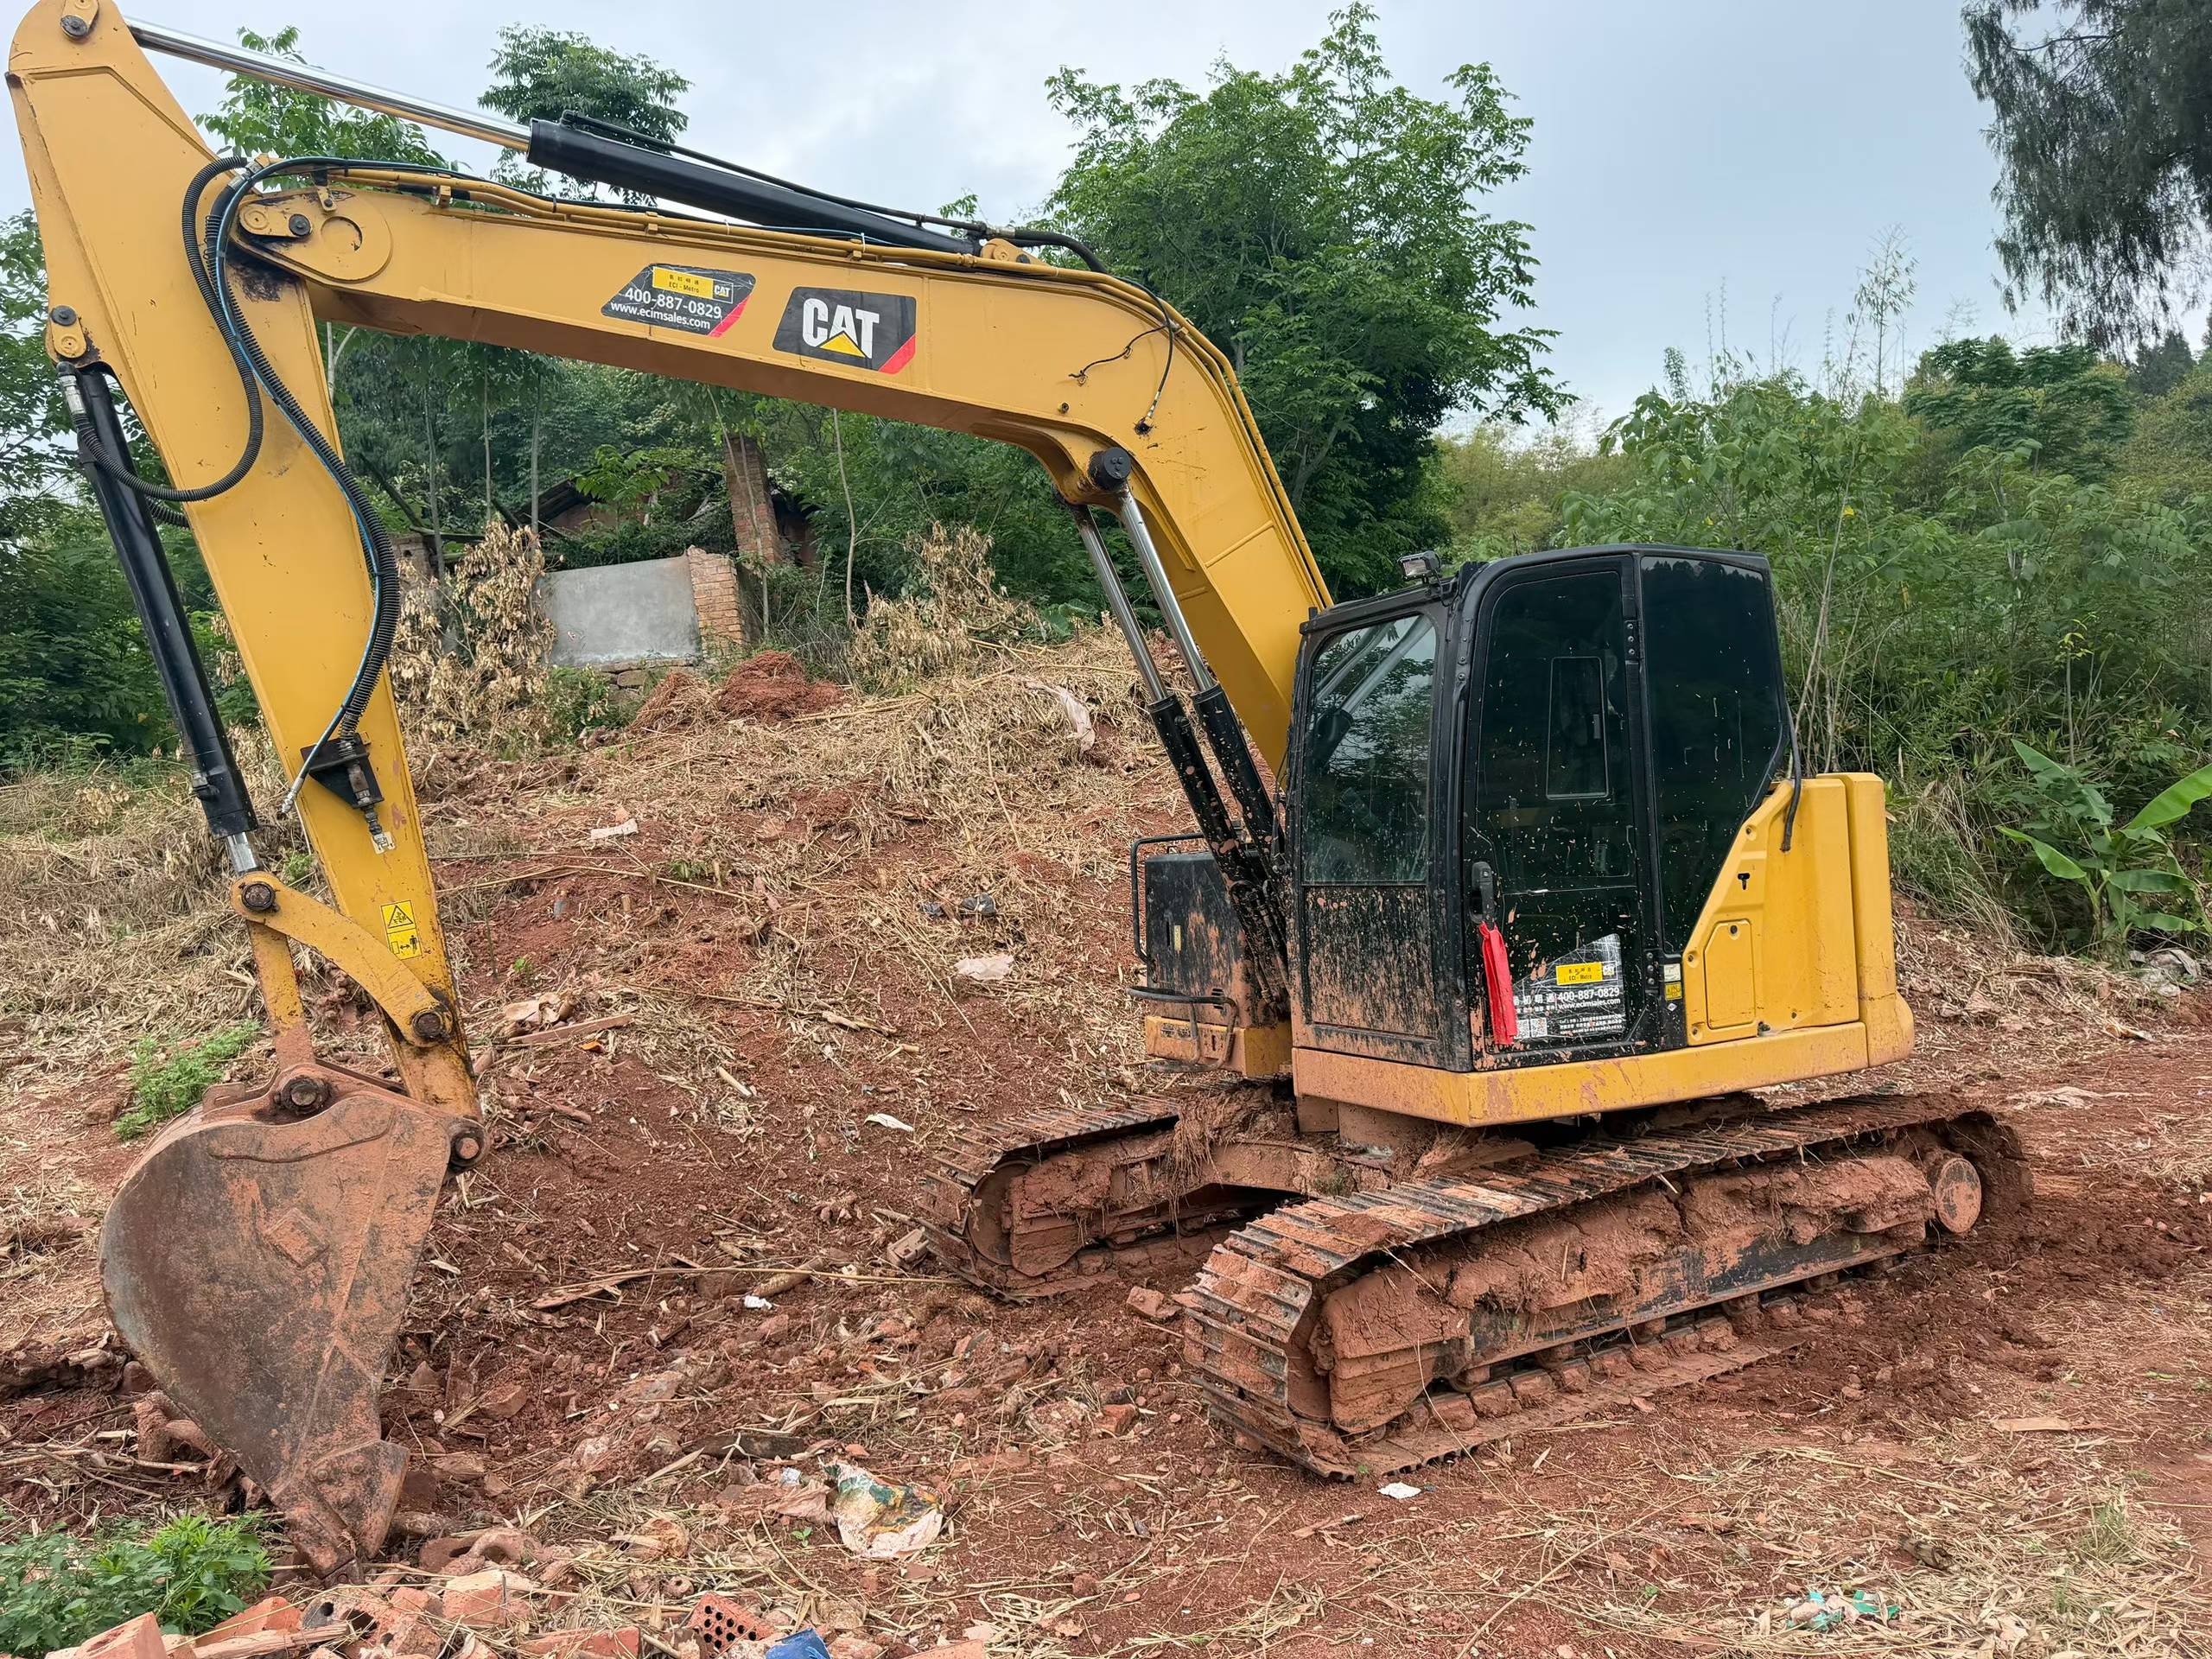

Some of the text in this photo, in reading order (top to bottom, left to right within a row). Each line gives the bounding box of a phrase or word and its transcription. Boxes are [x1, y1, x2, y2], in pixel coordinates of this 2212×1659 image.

[714, 284, 731, 298] CAT
[625, 288, 722, 320] 400-887-0829
[611, 302, 711, 330] www.ecimsales.com
[802, 298, 880, 359] CAT
[1558, 987, 1620, 1001] 400-887-0829
[1558, 998, 1621, 1009] www.ecimsales.com
